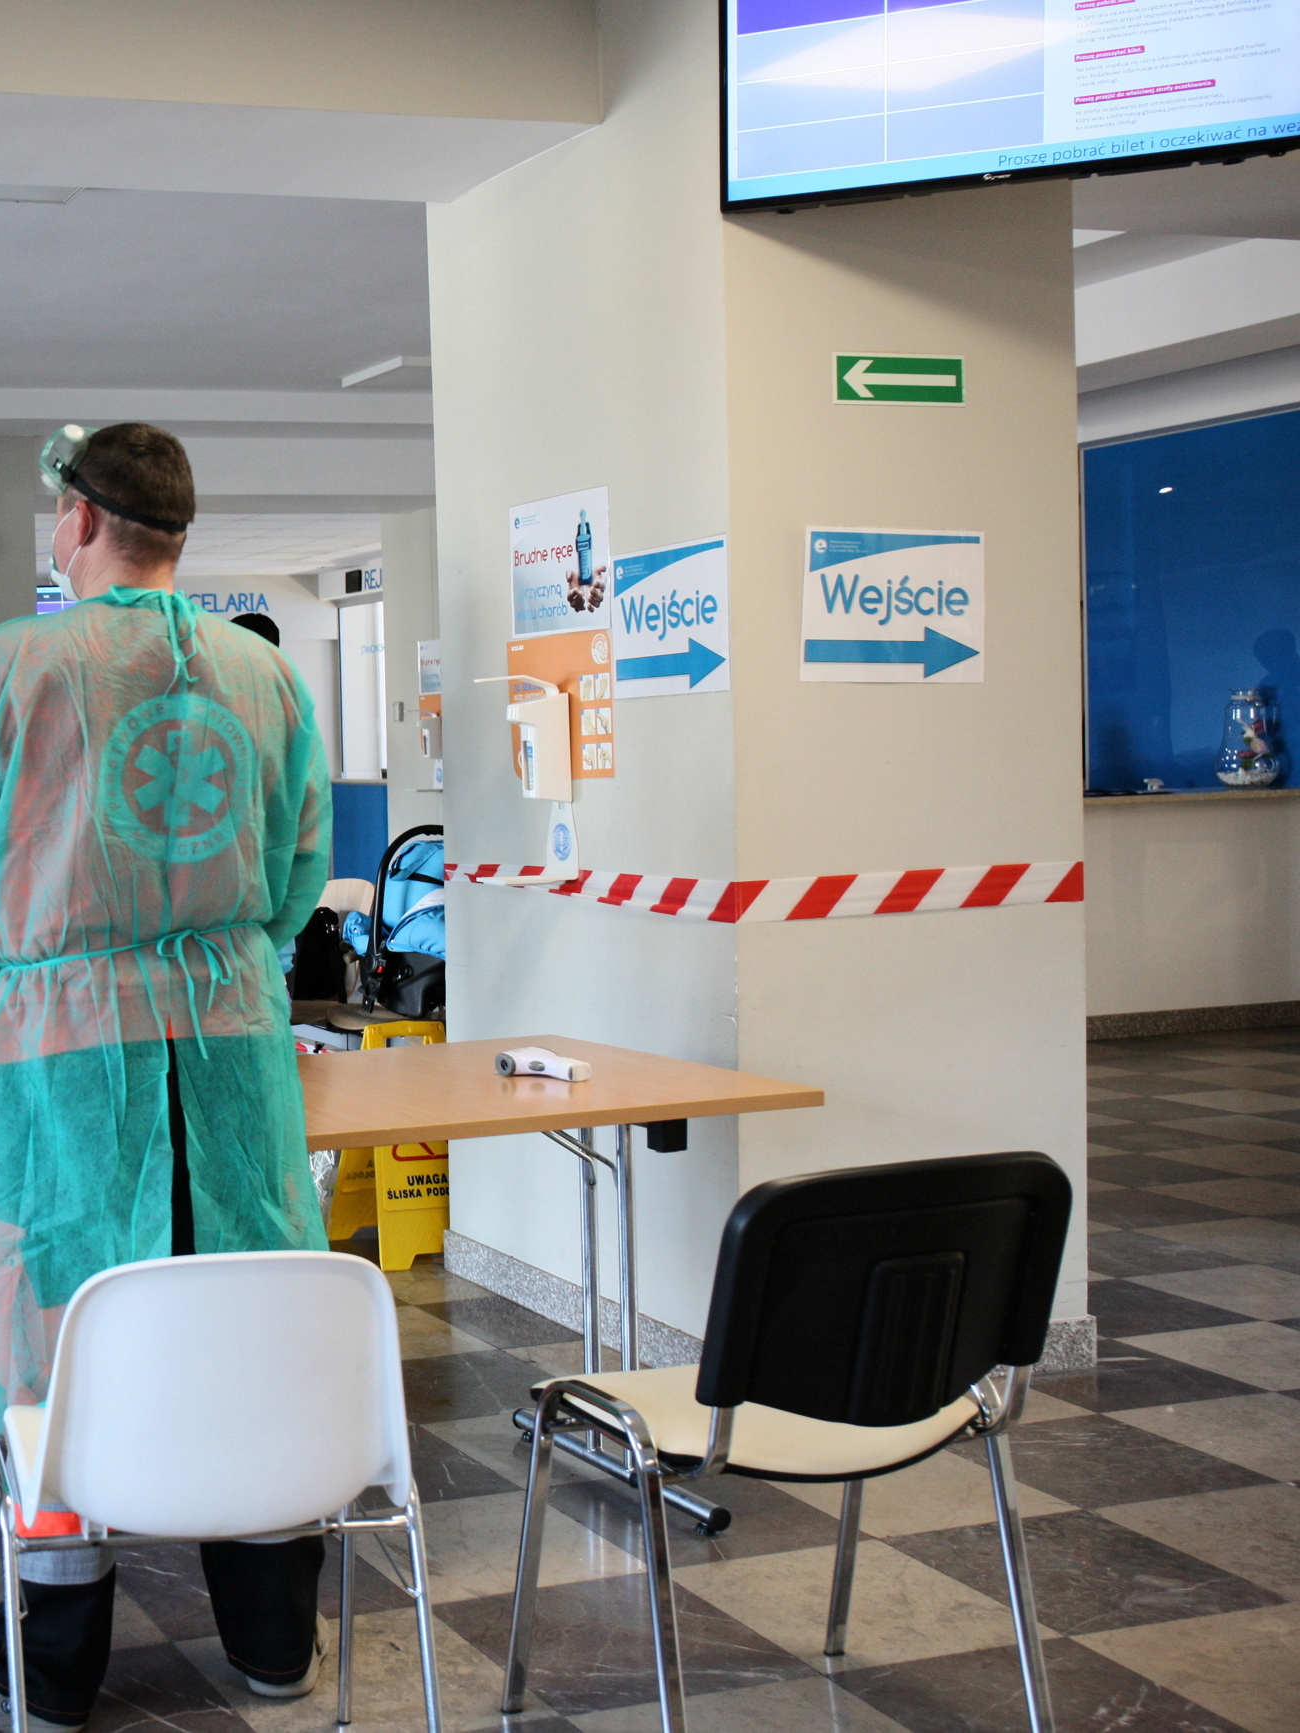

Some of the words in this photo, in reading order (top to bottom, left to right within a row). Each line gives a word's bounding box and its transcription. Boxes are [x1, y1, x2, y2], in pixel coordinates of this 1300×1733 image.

[998, 152, 1047, 168] Proszę
[1053, 141, 1106, 165] pobrać
[1111, 139, 1145, 155] bilet
[1150, 136, 1154, 149] i
[1160, 125, 1242, 149] oczekiwać
[1247, 124, 1267, 138] na
[514, 547, 549, 567] Brudne
[550, 543, 574, 564] ręce
[538, 602, 568, 619] chorób
[820, 573, 970, 626] Wejście
[620, 588, 718, 641] Wejście
[406, 1173, 449, 1187] UWAGA
[387, 1187, 423, 1200] ŚLISKA
